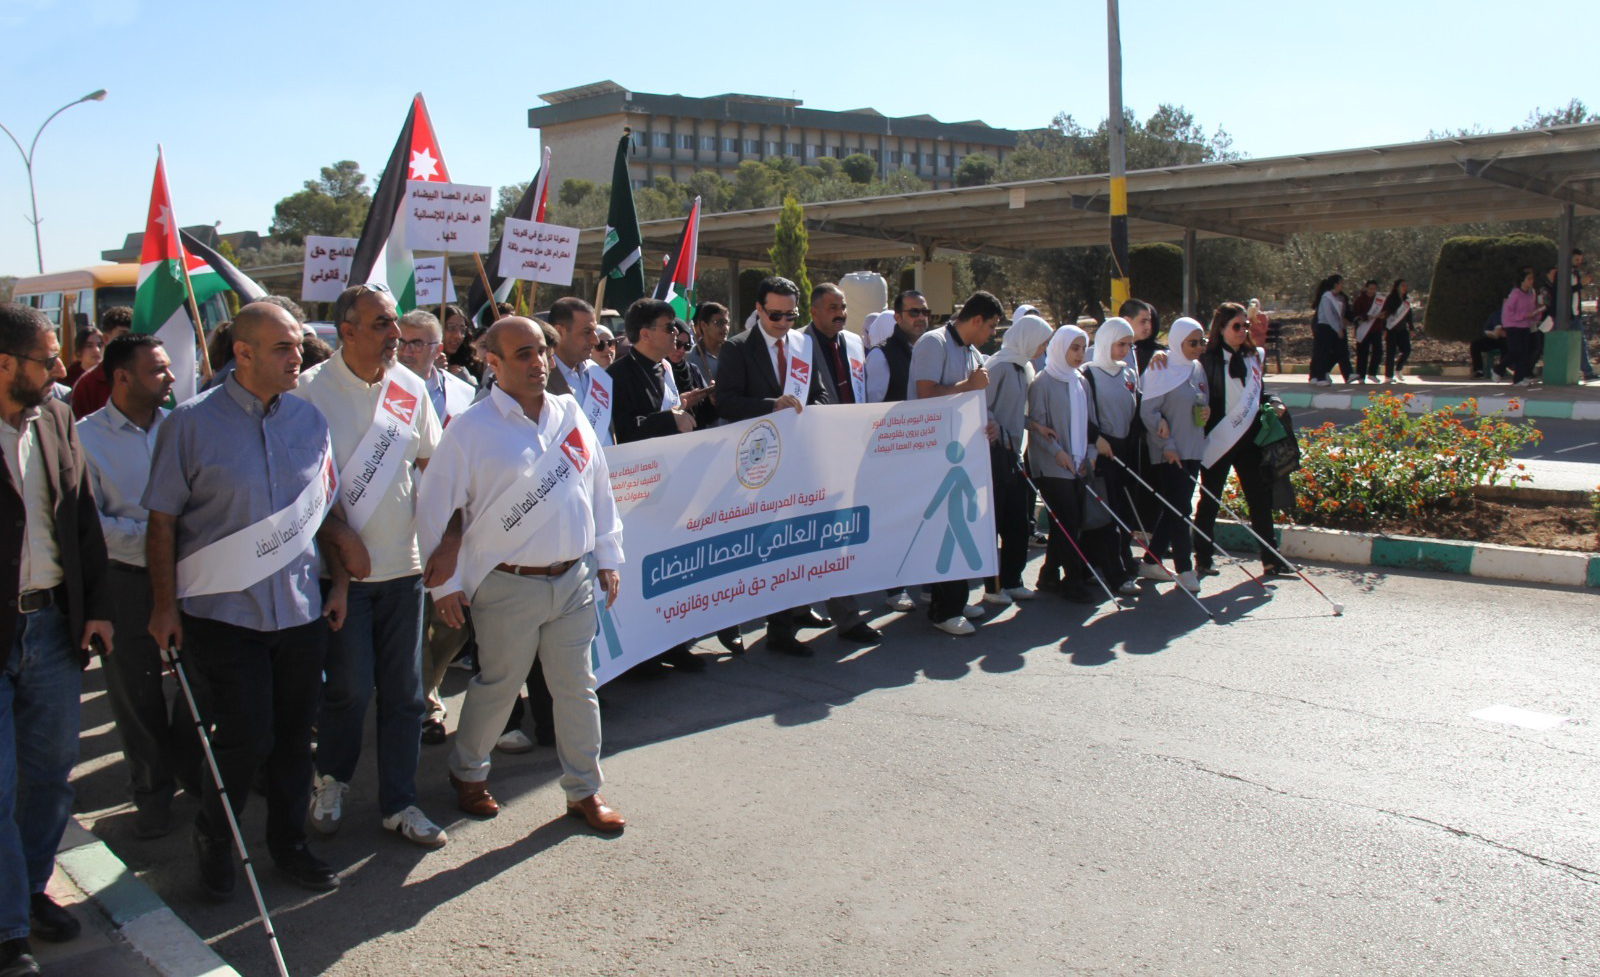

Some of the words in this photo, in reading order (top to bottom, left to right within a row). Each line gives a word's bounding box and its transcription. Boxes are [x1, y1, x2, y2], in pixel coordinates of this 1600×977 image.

[412, 189, 438, 201] البيضاء
[441, 191, 461, 200] العصا
[463, 193, 485, 205] احترام
[447, 211, 468, 223] احترام
[471, 214, 481, 223] هو
[442, 231, 456, 242] كلها
[311, 246, 326, 258] حق
[311, 268, 339, 283] قانوني
[906, 414, 923, 425] اليوم
[925, 412, 942, 423] نحتفل
[387, 416, 399, 441] اليوم
[920, 426, 935, 437] الذين
[372, 434, 391, 466] العالمي
[874, 443, 895, 453] البيضاء
[896, 441, 912, 450] العصا
[913, 441, 925, 450] يوم
[926, 438, 937, 448] في
[357, 460, 377, 483] للعصا
[555, 457, 570, 482] اليوم
[619, 464, 639, 476] البيضاء
[640, 460, 658, 471] بالعصا
[345, 478, 366, 506] البيضاء
[534, 470, 558, 502] العالمي
[516, 491, 538, 514] للعصا
[760, 493, 796, 513] المدرسة
[798, 487, 826, 506] ثانوية
[501, 505, 523, 532] البيضاء
[718, 500, 758, 523] الأسقفية
[279, 520, 298, 544] للعصا
[686, 512, 717, 532] العربية
[819, 512, 860, 548] اليوم
[256, 531, 281, 558] البيضاء
[707, 533, 754, 566] للعصا
[758, 519, 817, 562] العالمي
[651, 544, 704, 586] البيضاء
[747, 576, 766, 596] حق
[770, 564, 805, 591] الدامج
[711, 578, 745, 604] شرعي
